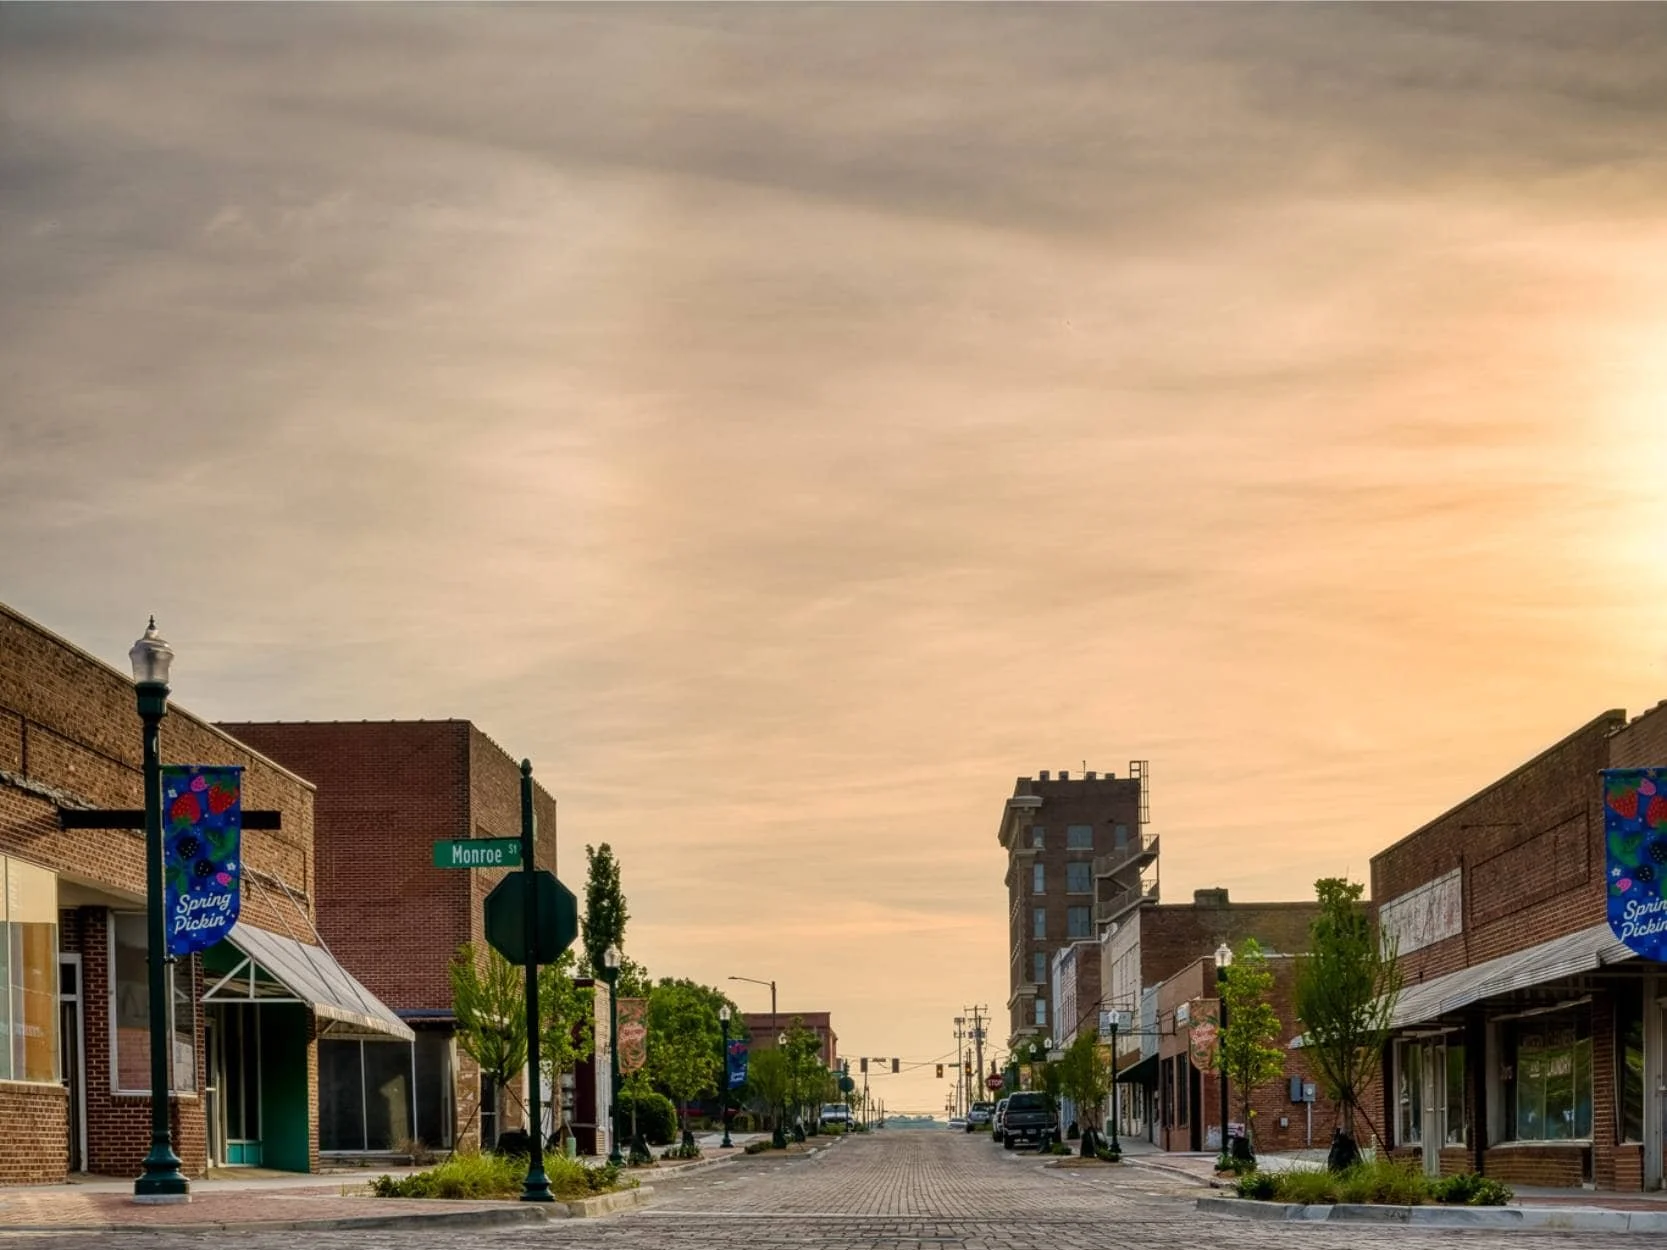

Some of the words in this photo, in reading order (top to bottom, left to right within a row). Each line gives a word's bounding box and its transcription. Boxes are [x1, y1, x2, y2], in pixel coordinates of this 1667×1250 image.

[452, 844, 503, 865] Monroe
[508, 843, 518, 855] St
[176, 892, 232, 916] Spring
[1623, 896, 1667, 922] Sprin
[174, 909, 232, 936] Pickin'
[987, 1079, 1003, 1087] STOP
